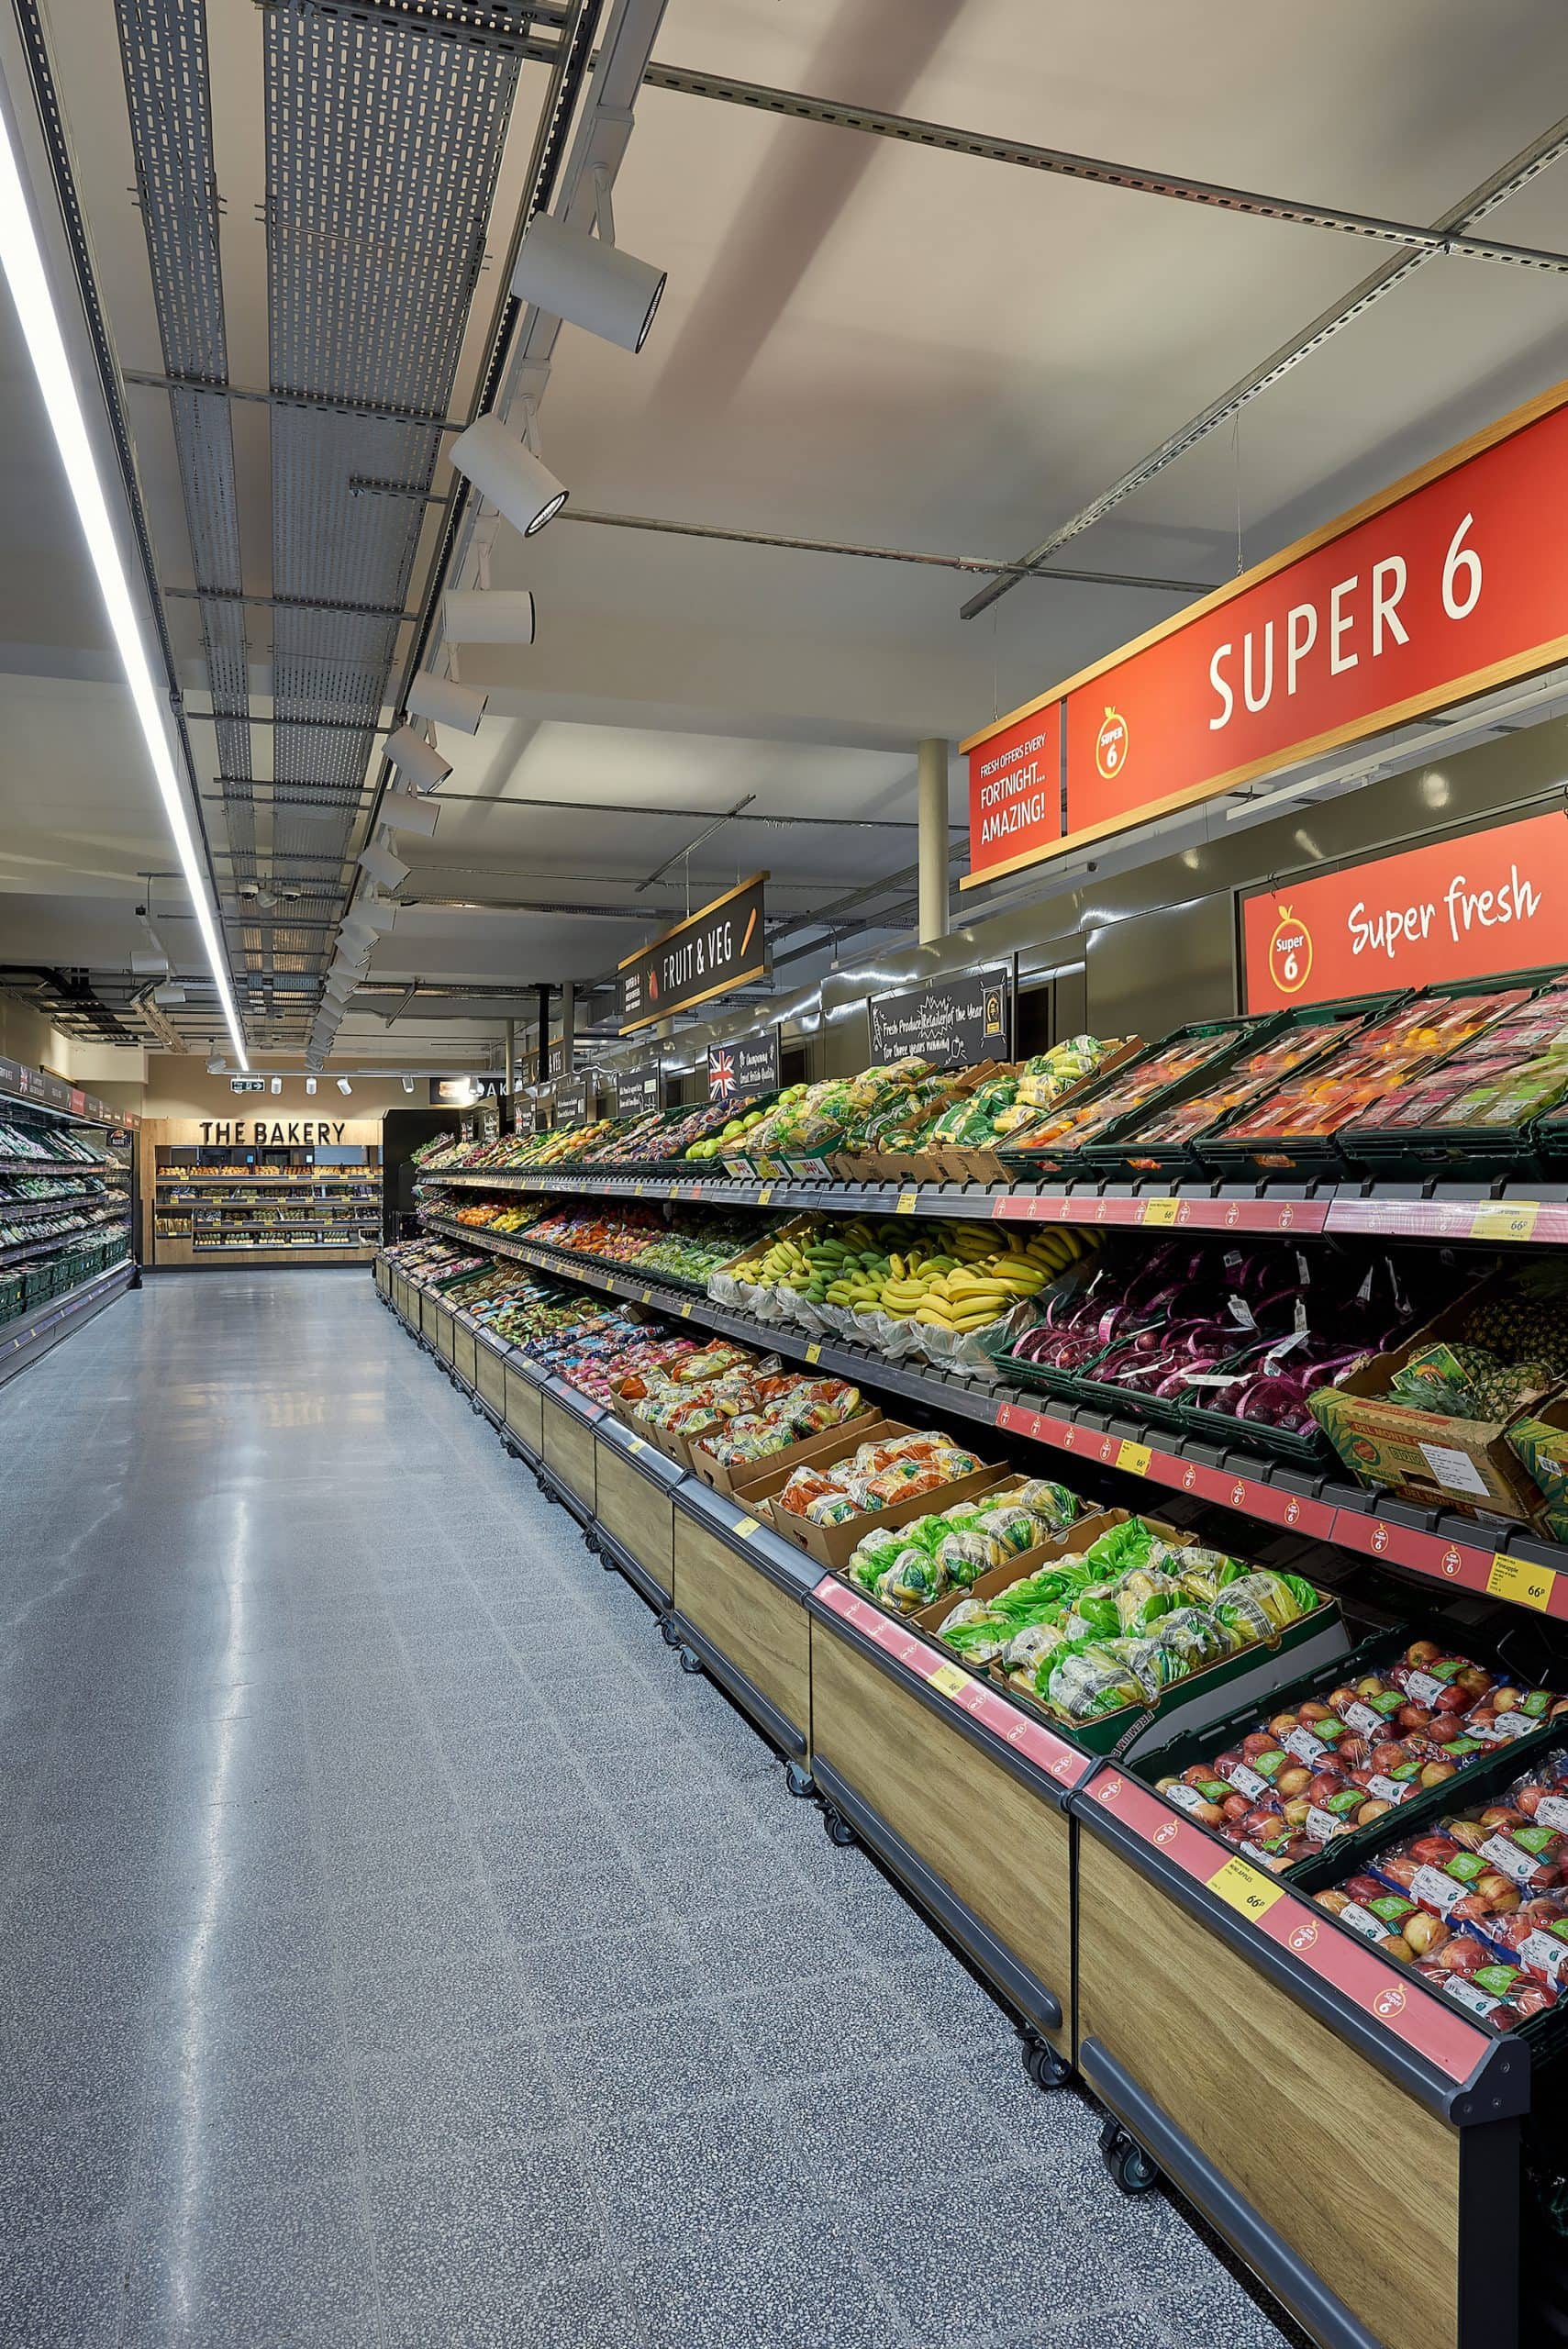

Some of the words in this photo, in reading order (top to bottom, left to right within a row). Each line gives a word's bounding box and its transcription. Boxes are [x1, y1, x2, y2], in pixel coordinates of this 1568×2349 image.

[1209, 555, 1410, 730] SUPER
[1441, 512, 1484, 620] 6
[1100, 726, 1123, 747] SUPER
[980, 759, 1000, 778] FRESH
[1000, 746, 1024, 769] OFFERS
[1024, 732, 1047, 756] EVERY
[1106, 744, 1118, 768] 6
[981, 762, 1046, 809] FORTNIGHT...
[981, 792, 1045, 845] AMAZING!
[1347, 901, 1436, 959] Super
[1443, 864, 1542, 942] fresh
[1275, 934, 1305, 953] Super
[663, 943, 693, 992] FRUIT
[696, 938, 705, 974] &
[707, 920, 732, 968] VEG
[1284, 952, 1299, 980] 6
[883, 1021, 898, 1037] Fresh
[899, 1016, 922, 1034] Produce
[955, 1008, 966, 1022] the
[967, 1003, 983, 1019] Year
[883, 1043, 893, 1061] for
[893, 1041, 908, 1056] three
[909, 1040, 926, 1056] years
[199, 1122, 246, 1145] THE
[254, 1122, 345, 1145] BAKERY
[1354, 1424, 1373, 1435] DEL
[1374, 1428, 1412, 1444] MONTE
[1287, 1513, 1294, 1522] 6
[1375, 1541, 1382, 1550] 6
[1446, 1564, 1454, 1574] 6
[1528, 1586, 1545, 1598] 66p
[1115, 1709, 1155, 1751] PREMIUM
[1101, 1791, 1110, 1799] 6
[1156, 1833, 1166, 1842] 6
[1246, 1895, 1265, 1908] 66p
[1294, 1937, 1305, 1947] 6
[1379, 2002, 1392, 2014] 6
